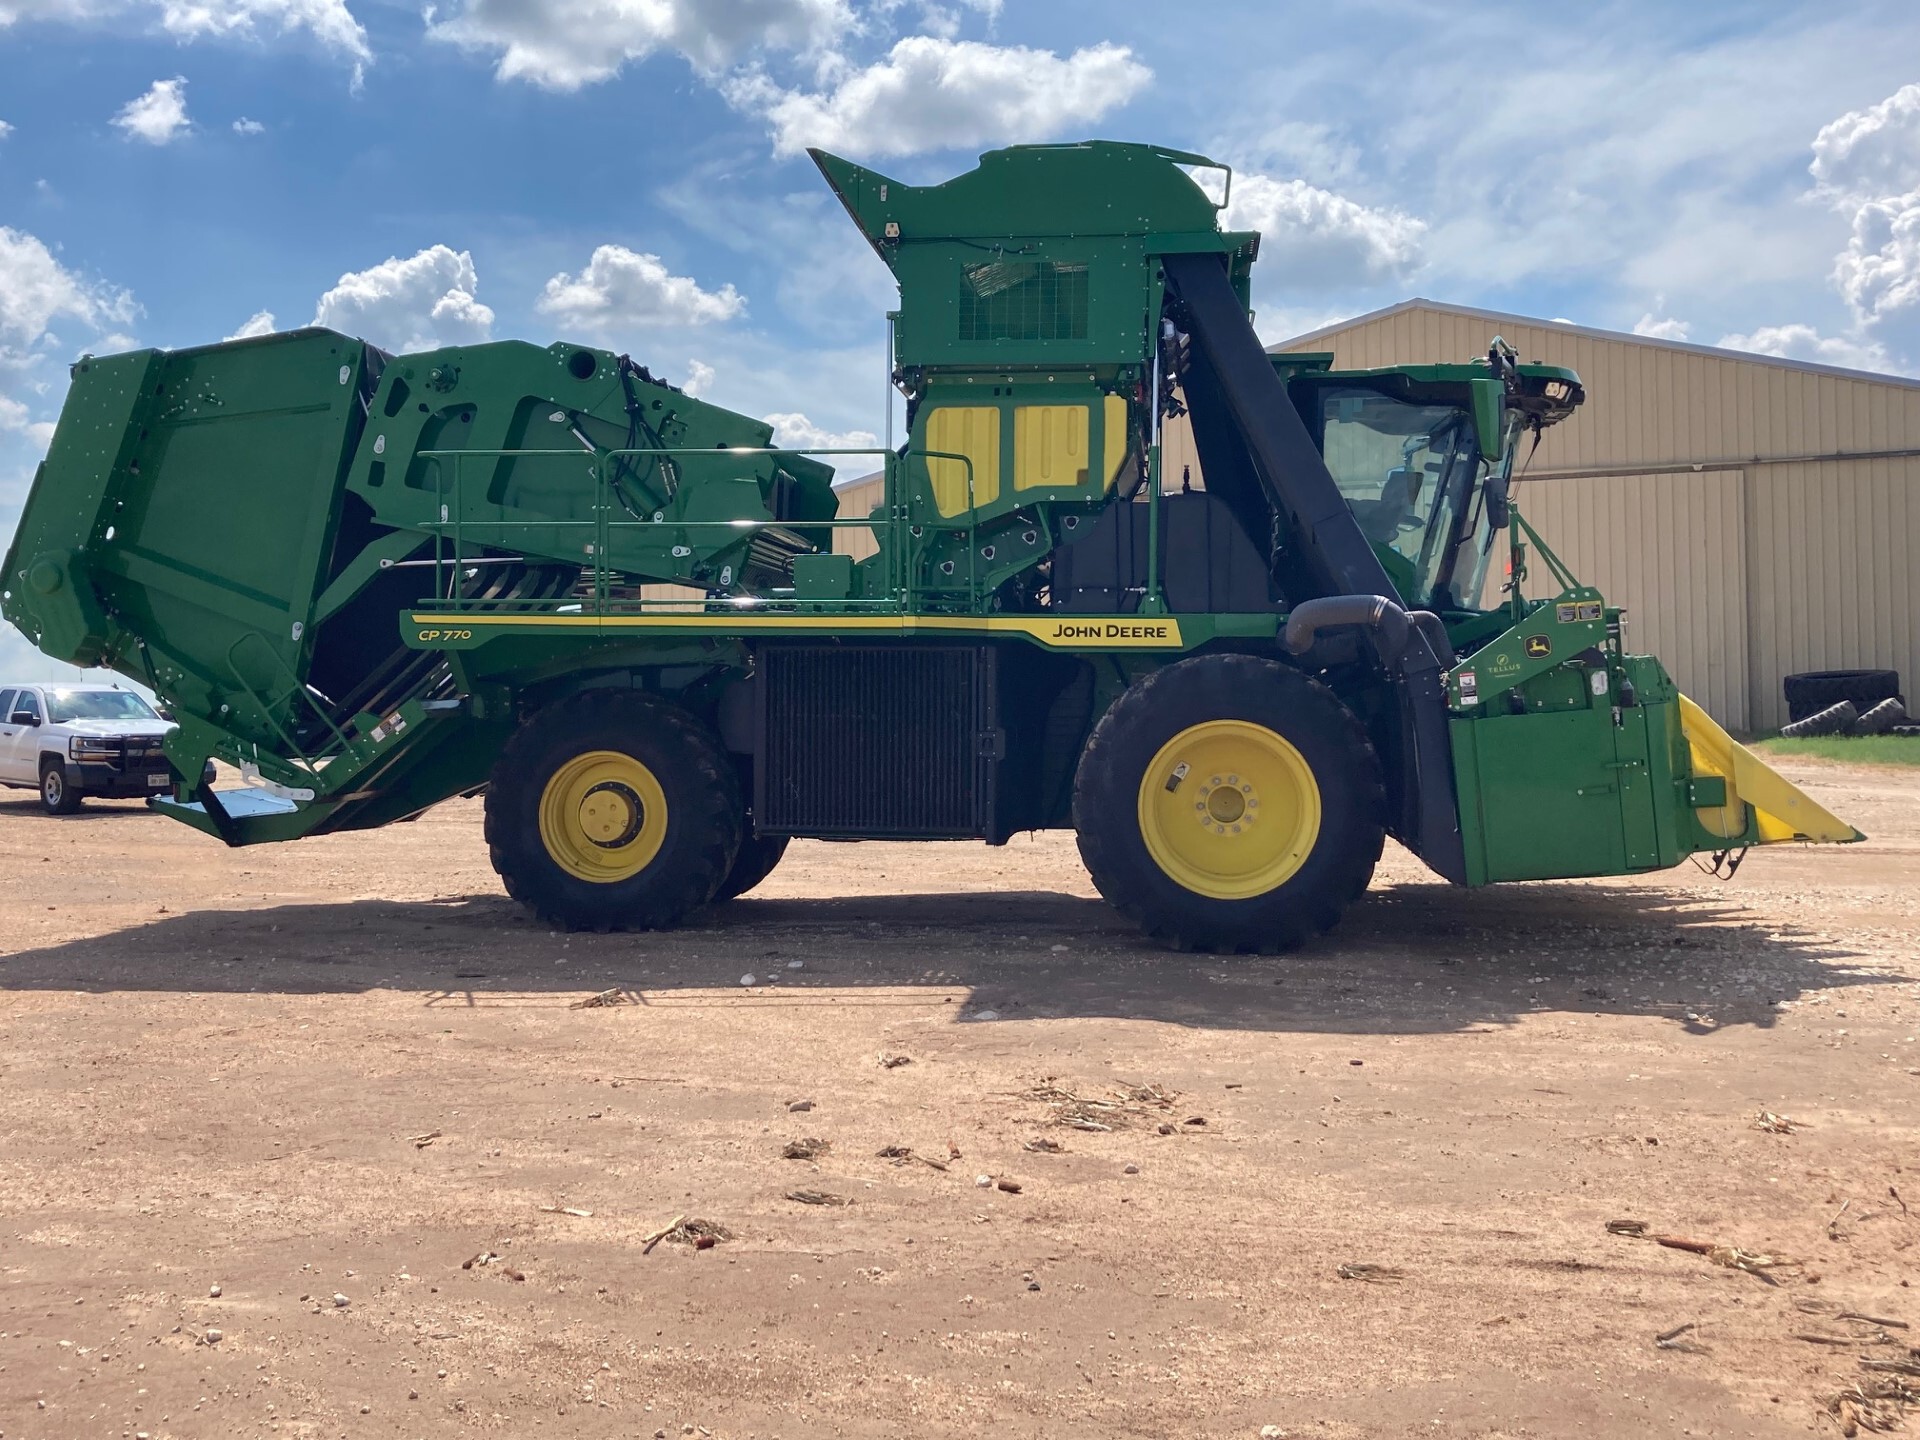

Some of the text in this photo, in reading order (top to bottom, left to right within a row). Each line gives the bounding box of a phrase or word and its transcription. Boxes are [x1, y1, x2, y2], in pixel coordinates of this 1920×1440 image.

[418, 630, 471, 641] CP 770
[1052, 624, 1167, 638] JOHN DEERE
[1488, 663, 1521, 673] TELLUS
